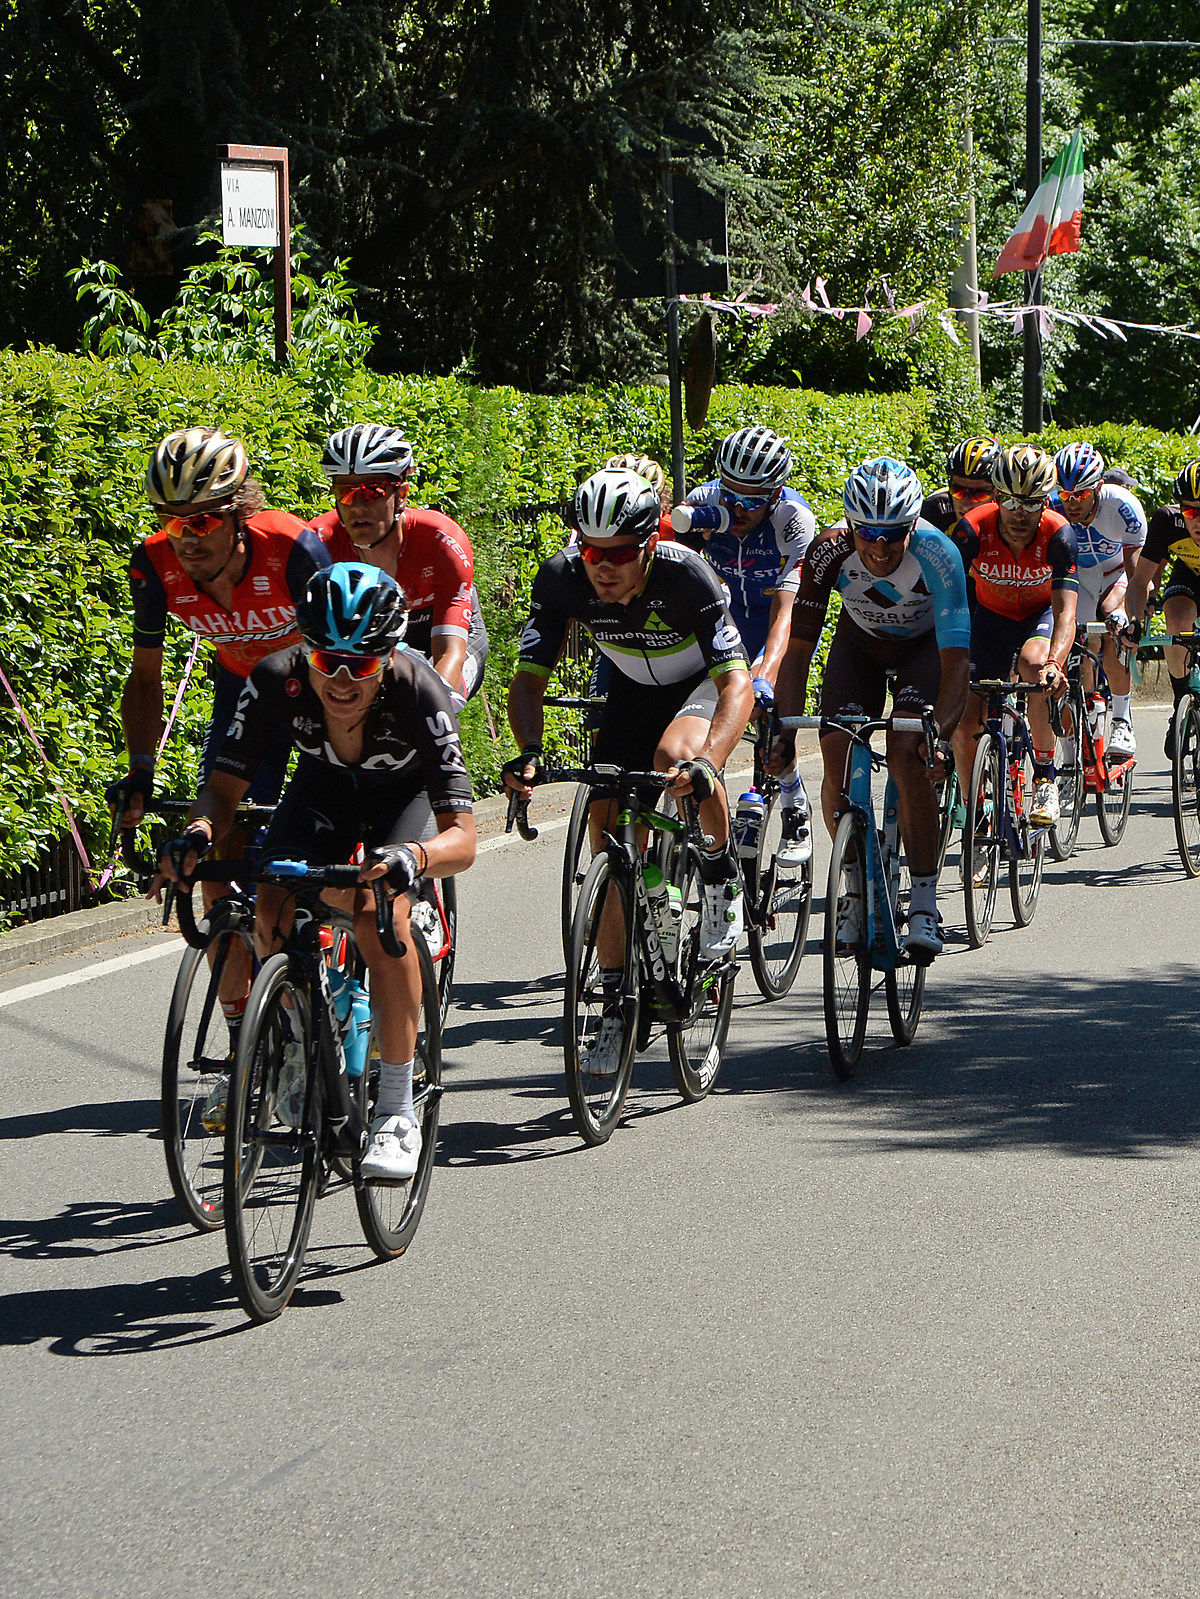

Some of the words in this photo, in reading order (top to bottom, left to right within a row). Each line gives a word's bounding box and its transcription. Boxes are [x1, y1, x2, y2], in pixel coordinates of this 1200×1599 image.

[227, 178, 240, 192] VIA
[435, 529, 472, 568] TREK
[809, 540, 832, 569] AG2R
[813, 544, 850, 585] MONDIALE
[980, 562, 1052, 580] BAHRAIN
[801, 600, 827, 609] FACTO
[188, 605, 297, 634] AHRAIN
[595, 631, 680, 641] dimension
[646, 636, 684, 648] data
